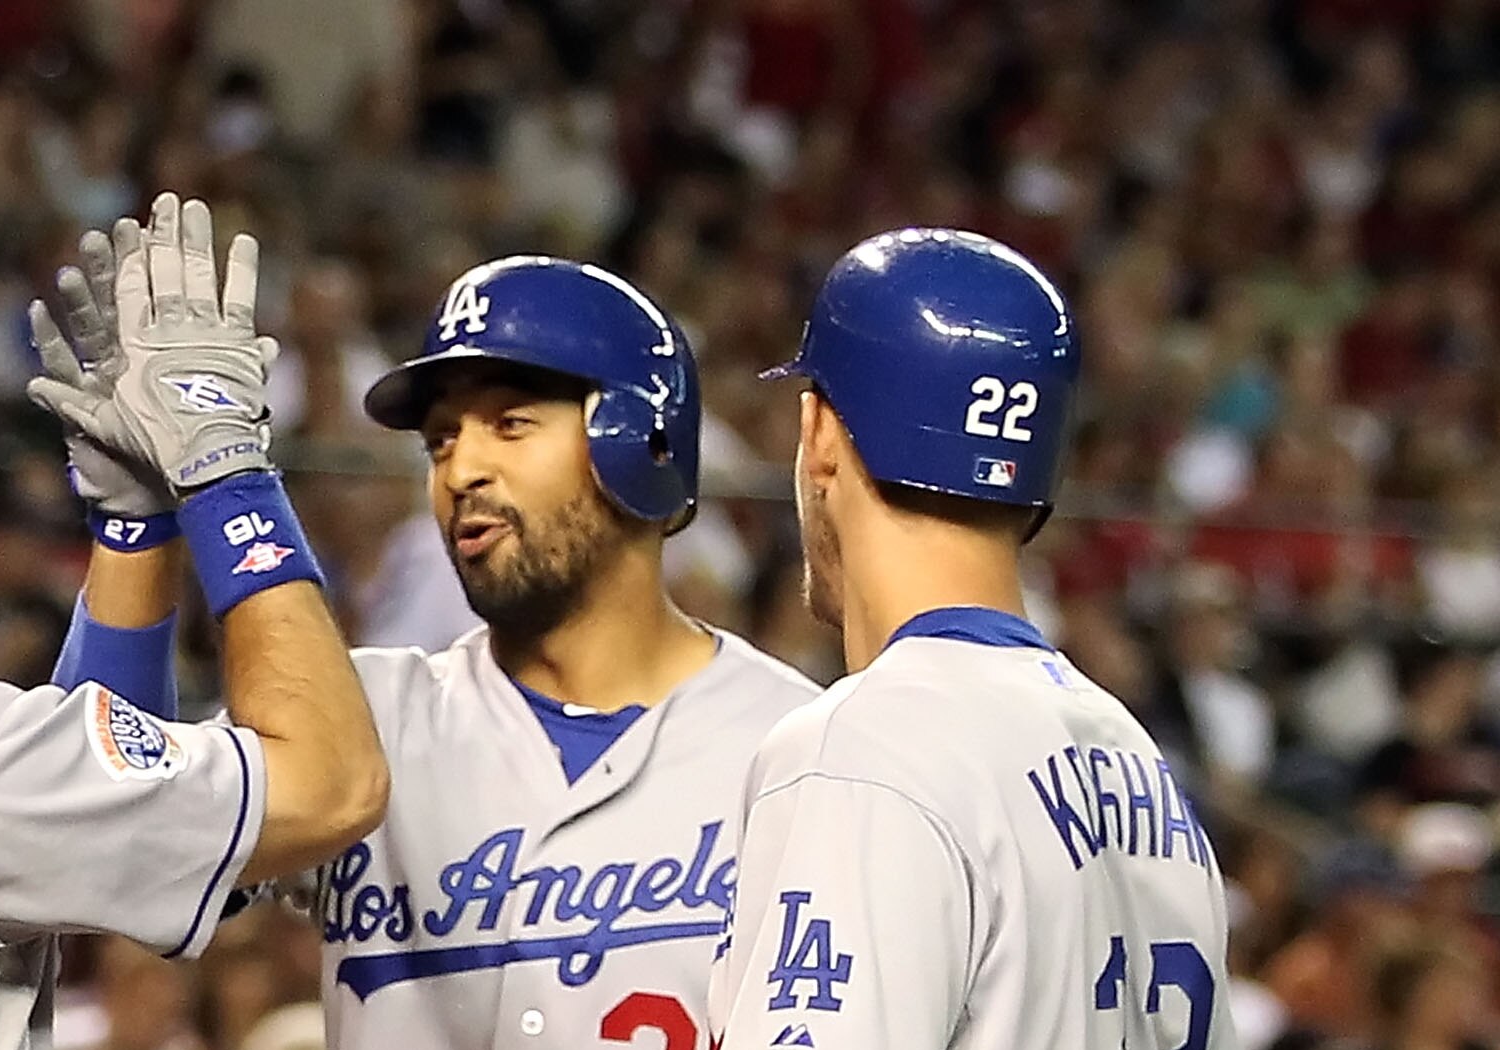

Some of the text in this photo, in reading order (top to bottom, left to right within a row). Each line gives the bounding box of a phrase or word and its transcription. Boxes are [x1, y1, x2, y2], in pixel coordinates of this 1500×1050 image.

[438, 282, 490, 341] LA
[964, 375, 1039, 442] 22
[179, 441, 263, 482] EASTON
[103, 518, 147, 544] 27
[324, 841, 414, 943] Los
[767, 890, 854, 1012] LA
